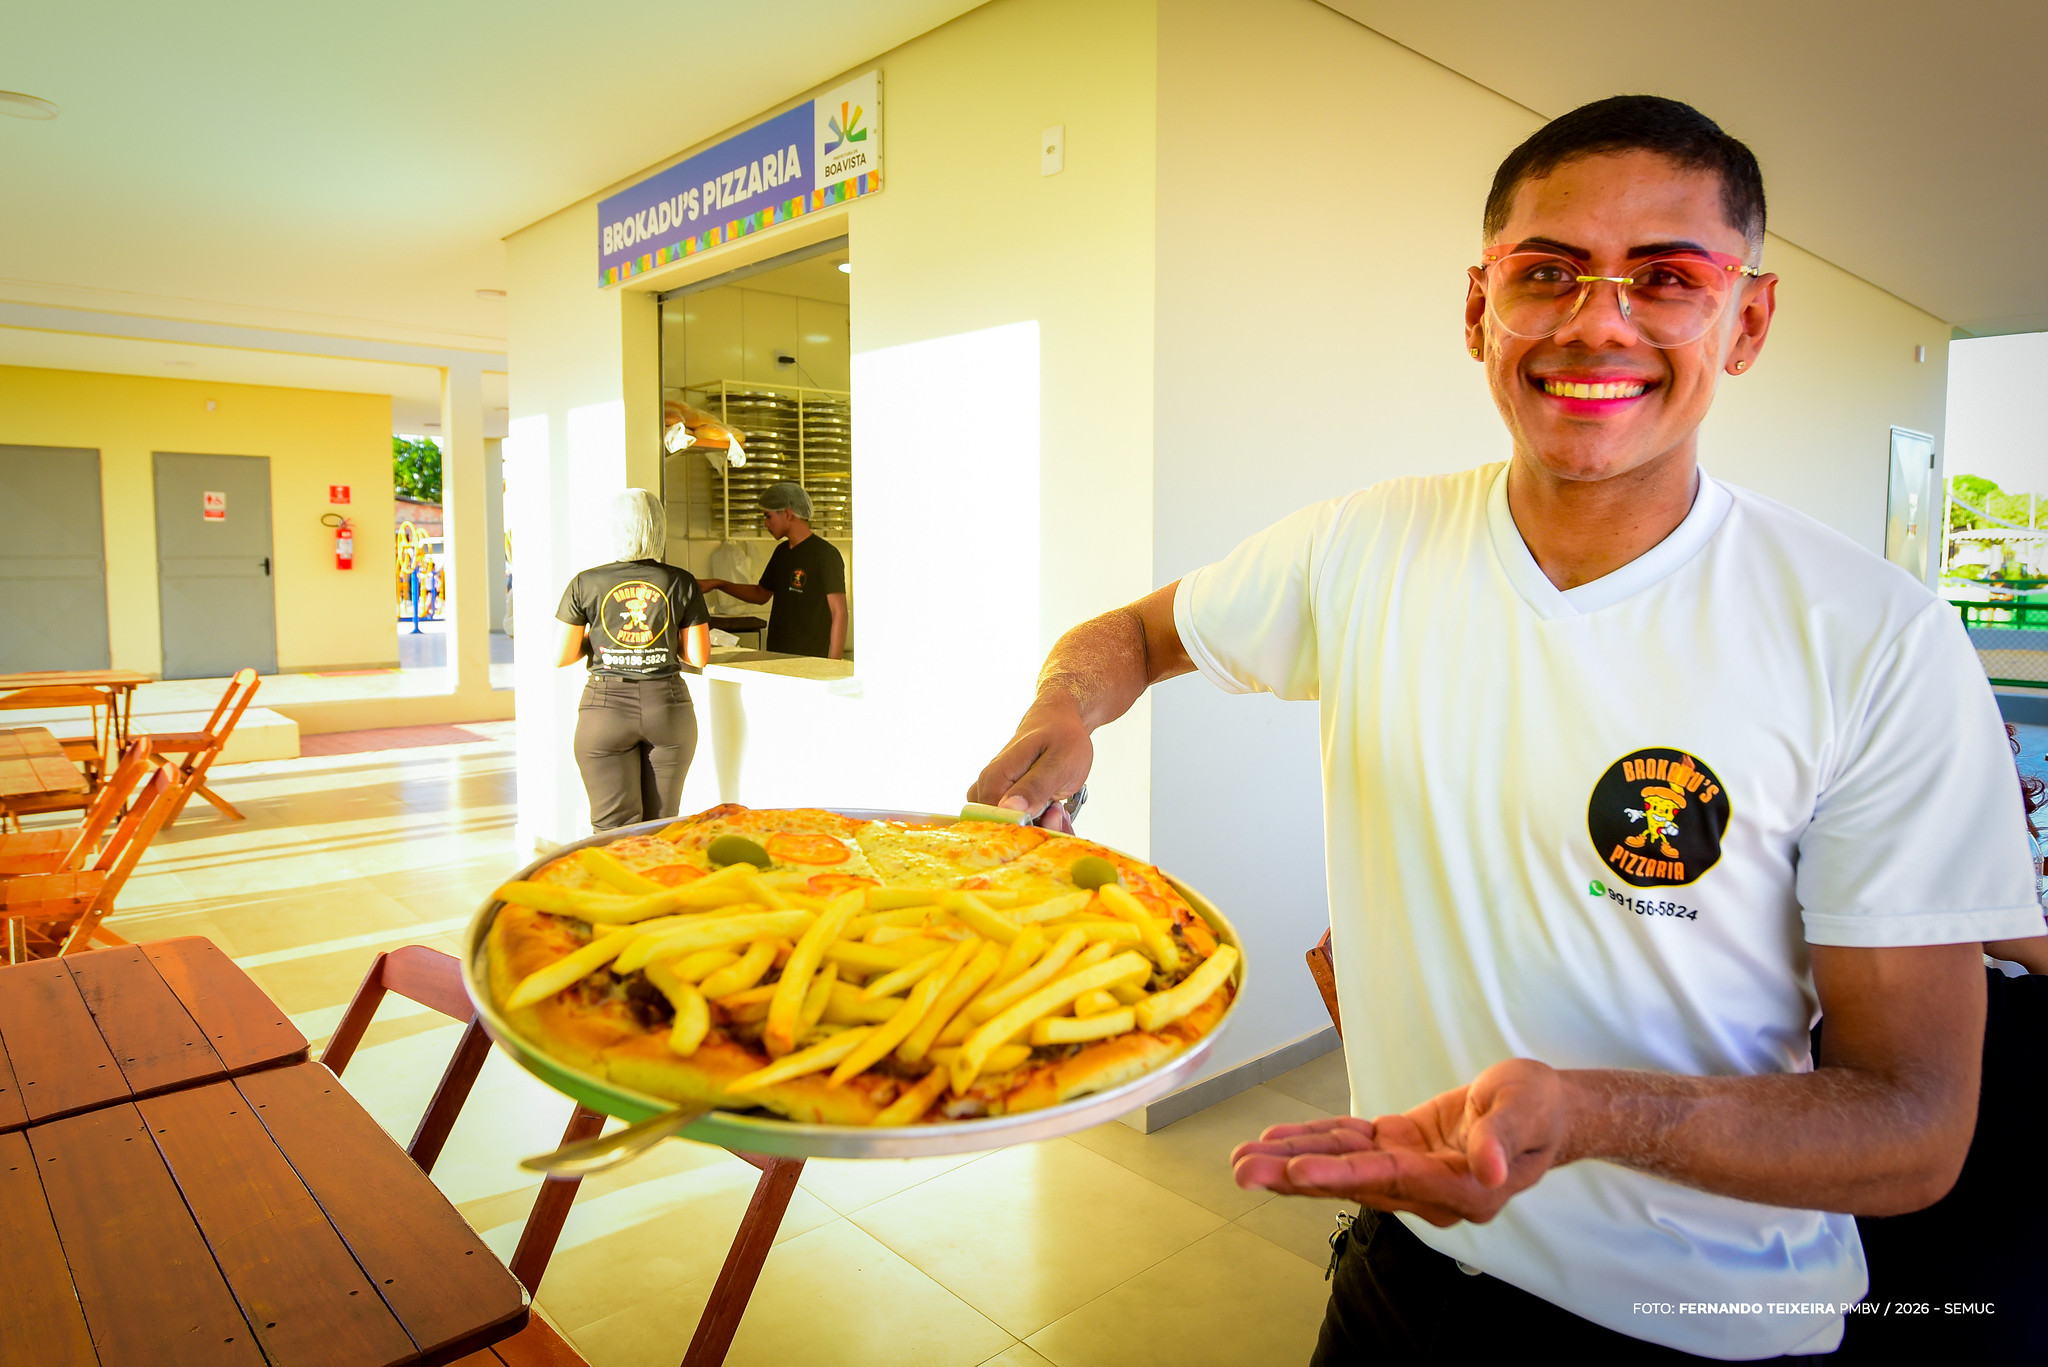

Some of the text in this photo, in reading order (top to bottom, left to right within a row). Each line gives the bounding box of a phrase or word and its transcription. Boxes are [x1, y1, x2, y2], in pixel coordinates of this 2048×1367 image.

[603, 144, 803, 256] BROKADU'S PIZZARIA
[1609, 844, 1685, 881] PIZZARIA
[1607, 888, 1699, 921] 99156-5824
